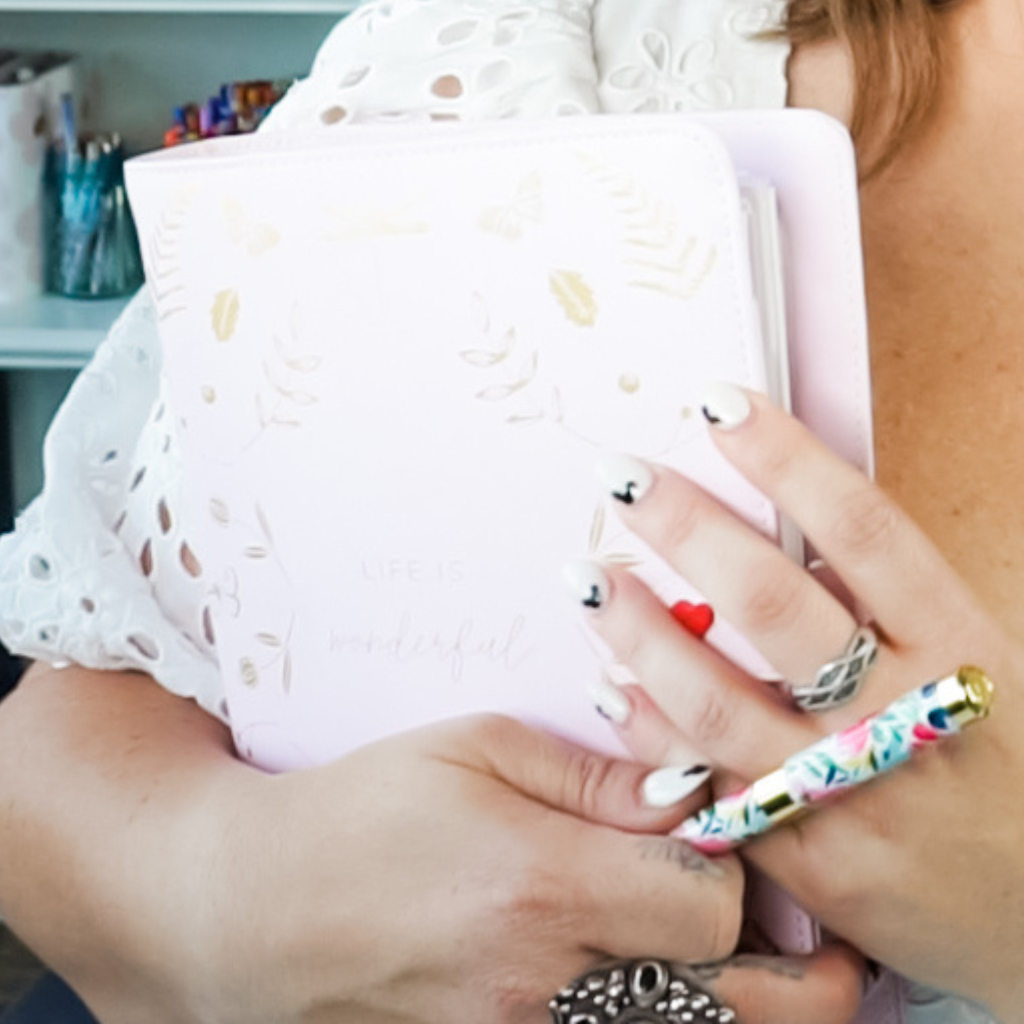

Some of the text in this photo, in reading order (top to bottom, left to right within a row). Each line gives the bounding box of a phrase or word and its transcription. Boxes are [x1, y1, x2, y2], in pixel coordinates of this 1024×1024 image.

[361, 559, 465, 582] LIFE IS
[328, 611, 535, 684] wonderful
